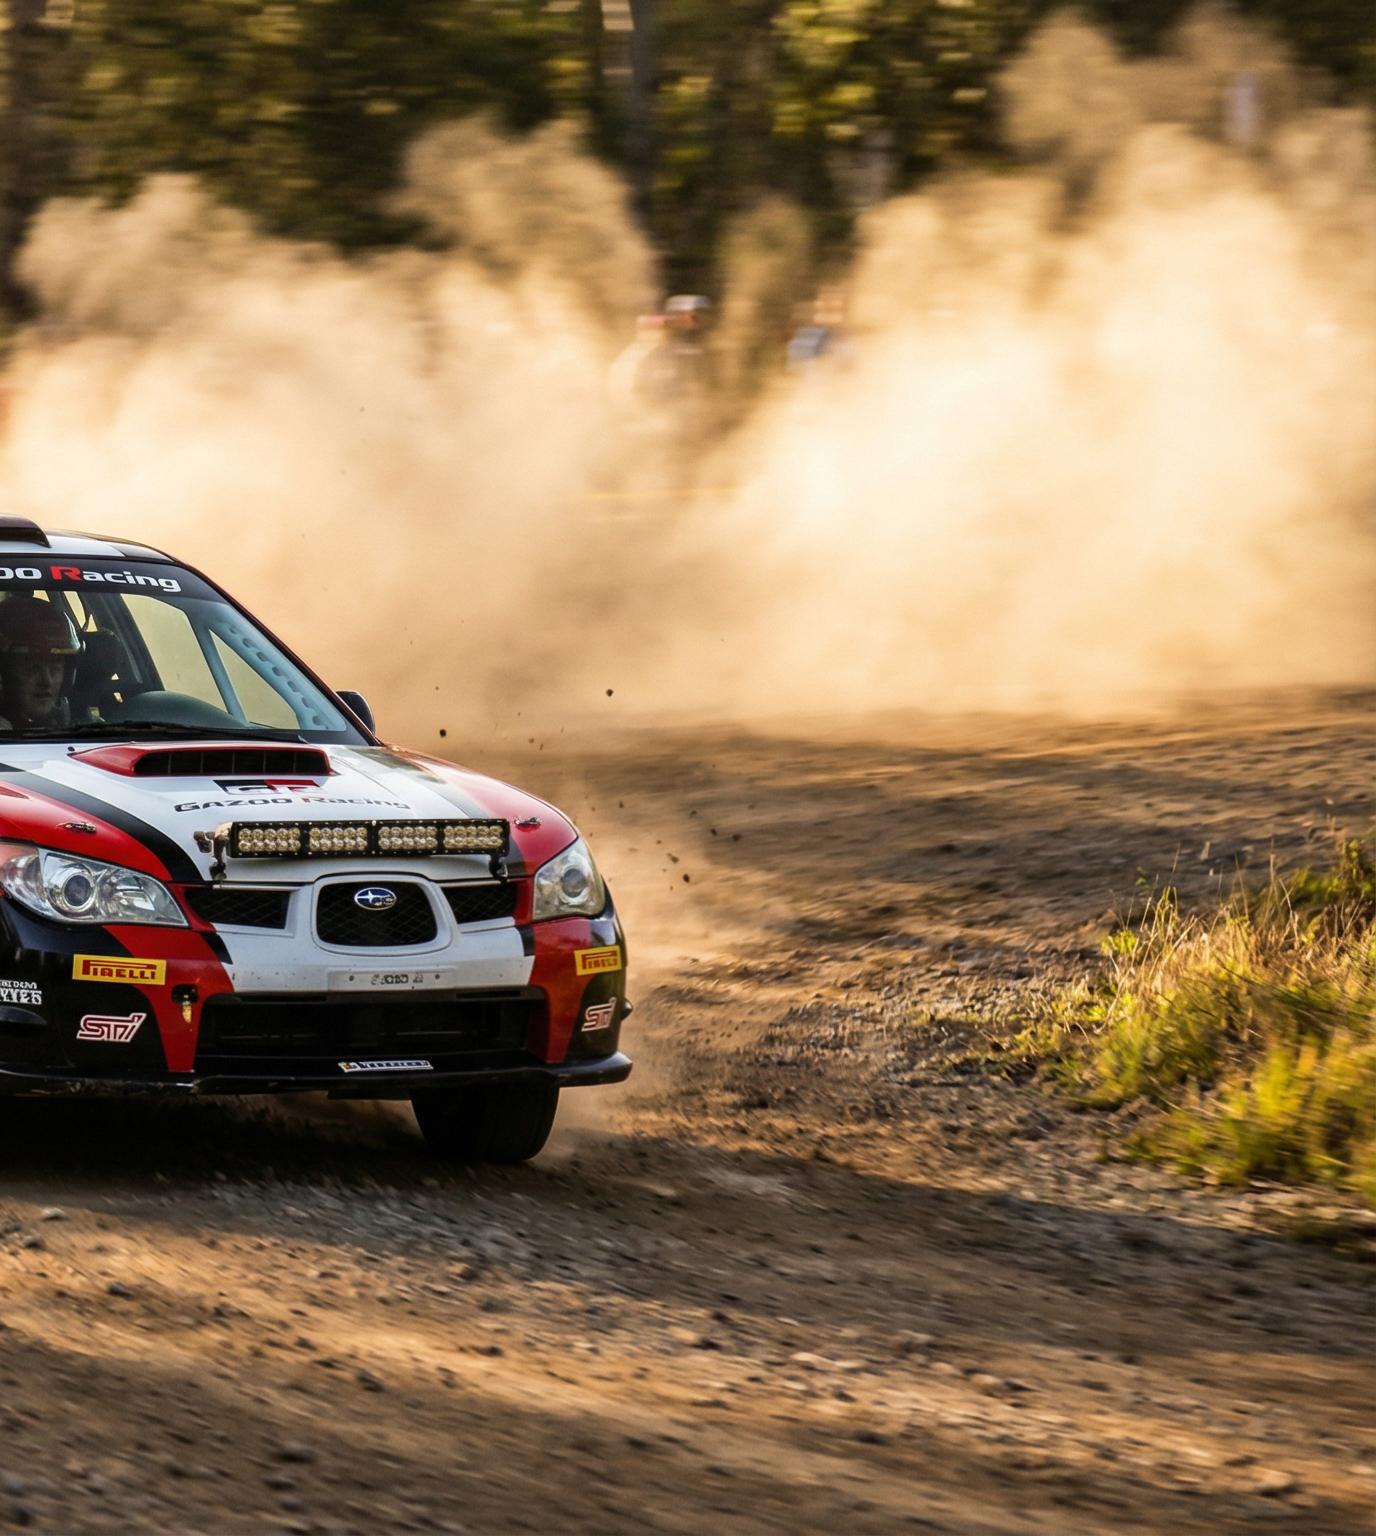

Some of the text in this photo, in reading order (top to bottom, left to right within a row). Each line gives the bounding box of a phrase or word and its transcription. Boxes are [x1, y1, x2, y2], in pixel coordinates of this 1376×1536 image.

[51, 566, 182, 591] Racing
[174, 796, 411, 812] GAZOO Racing
[82, 959, 157, 980] PIRELLI
